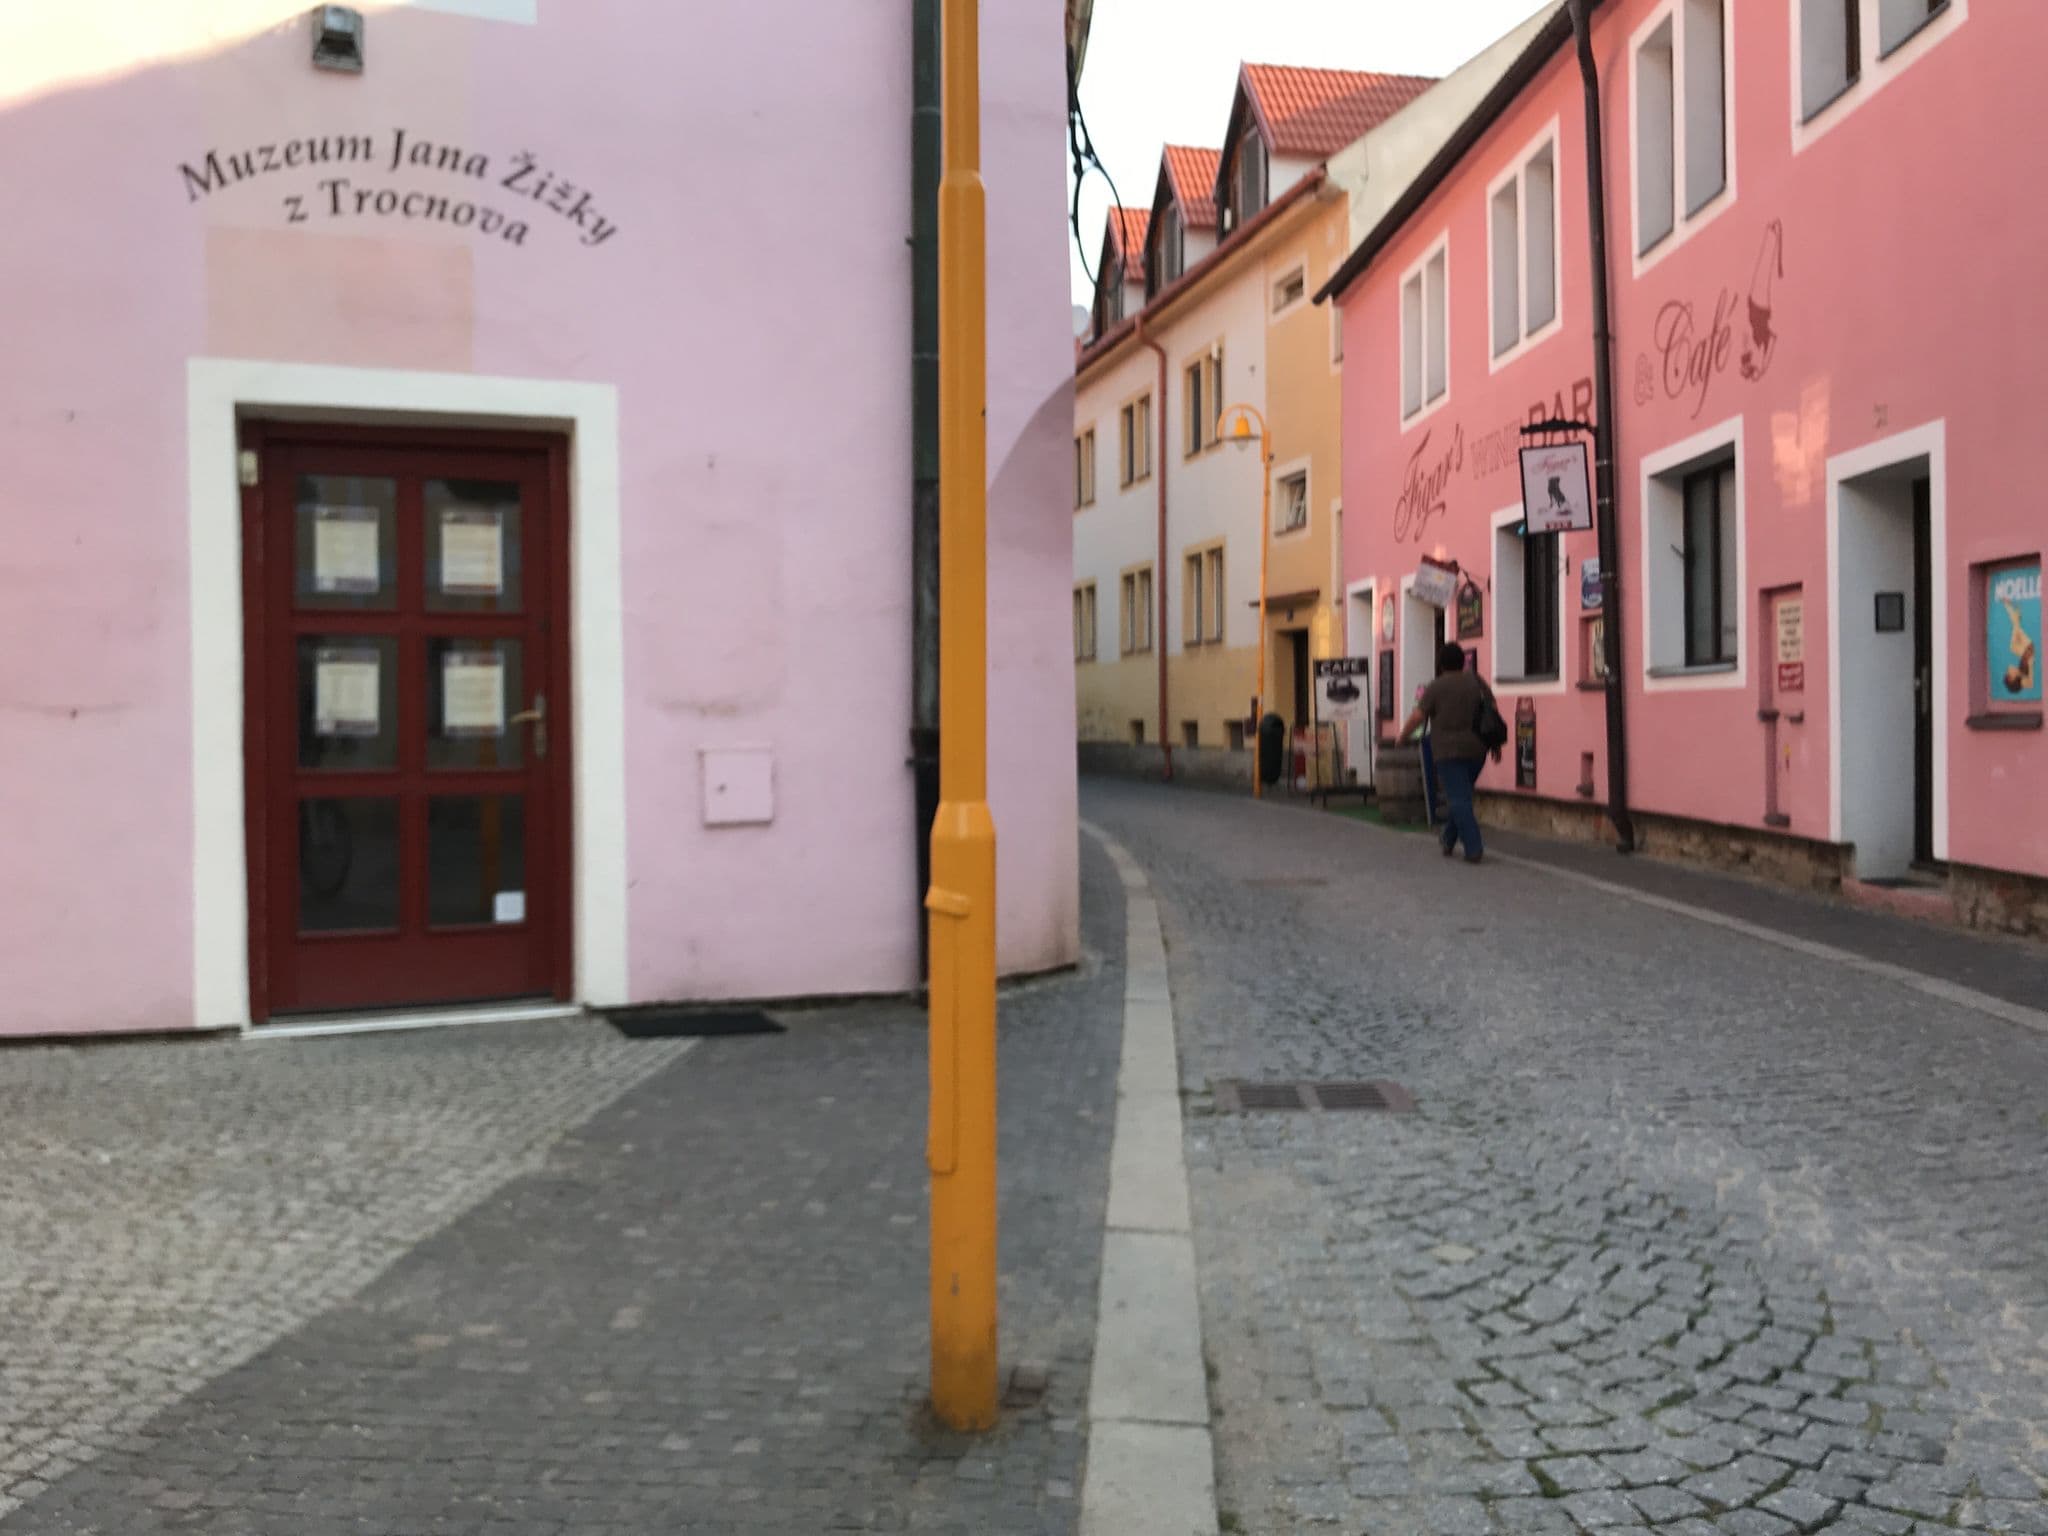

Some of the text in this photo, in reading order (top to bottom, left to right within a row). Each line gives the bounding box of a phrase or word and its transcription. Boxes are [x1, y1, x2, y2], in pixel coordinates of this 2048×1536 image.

[177, 127, 618, 247] Muzeum Jana Žižky
[283, 177, 530, 247] z Trocnova
[1654, 287, 1739, 420] Café
